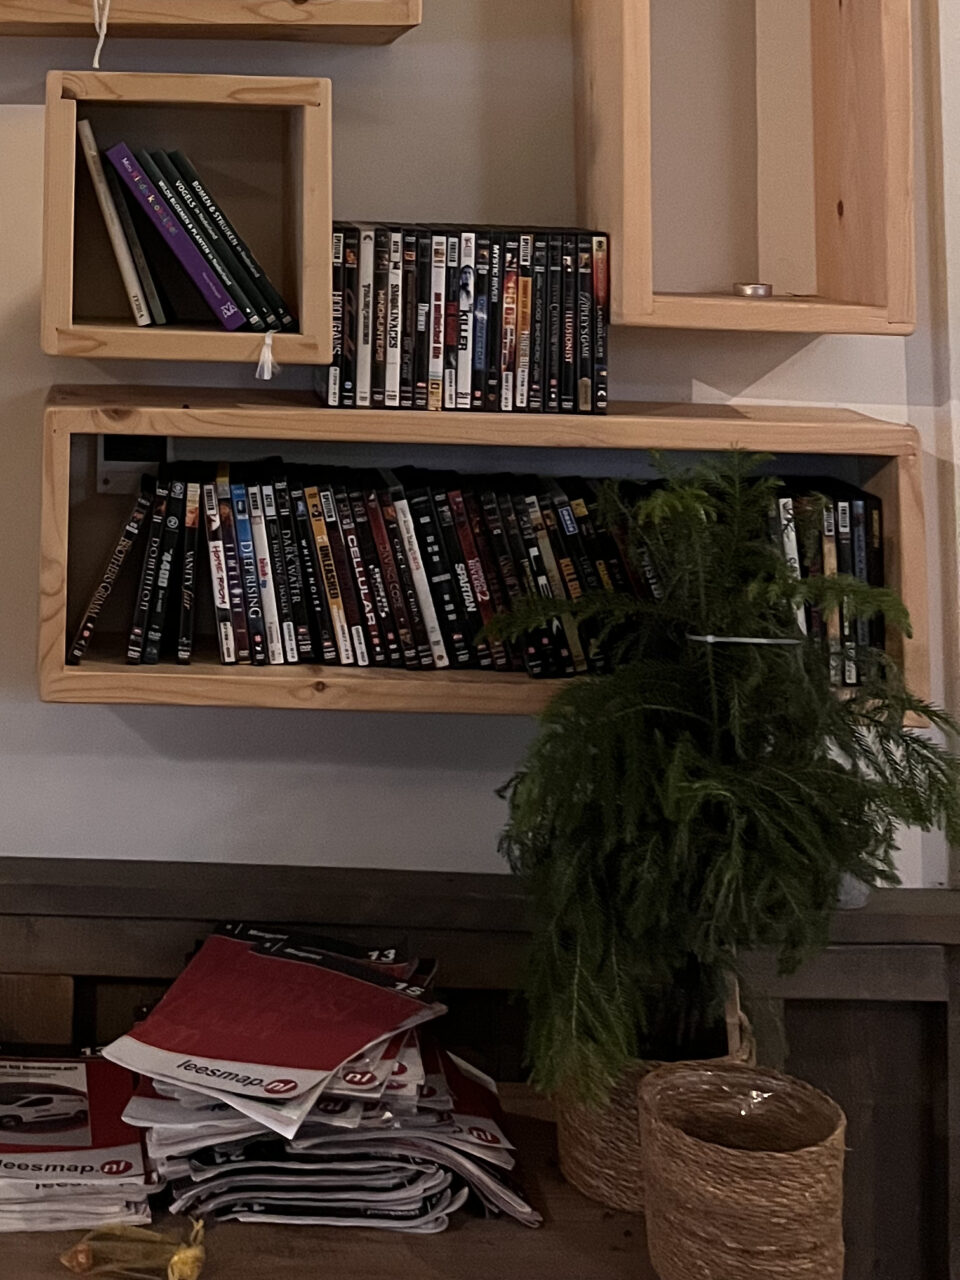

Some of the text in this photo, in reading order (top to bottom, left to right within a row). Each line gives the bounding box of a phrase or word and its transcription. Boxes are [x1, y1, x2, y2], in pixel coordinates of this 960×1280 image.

[174, 179, 197, 209] VOGELS
[191, 179, 213, 208] BOMEN
[208, 205, 217, 214] &
[157, 179, 174, 199] WILDE
[169, 197, 191, 225] BLOEMEN
[190, 228, 211, 255] PLANTEN
[211, 211, 239, 247] STRUIKEN
[491, 245, 500, 276] MYSTIC
[332, 292, 342, 355] HOOLIGANS
[458, 310, 468, 351] KILLER
[565, 311, 574, 364] ILLUSIONIST
[101, 536, 132, 584] BROTHERS
[157, 551, 172, 588] 4400
[211, 545, 224, 575] HOME
[272, 539, 284, 574] TRISTAN
[280, 529, 302, 604] DARK WATER
[319, 545, 340, 600] UNLEASHED
[181, 550, 194, 610] VANITY fair
[215, 577, 228, 606] ROOM
[240, 540, 262, 619] DEEP RISING
[300, 538, 321, 613] WHITE NOISE
[347, 534, 377, 626] CELLULAR
[454, 562, 477, 613] SPARTAN
[387, 582, 404, 610] CODE
[477, 591, 490, 603] 2
[368, 949, 396, 961] 13
[392, 982, 425, 996] 15
